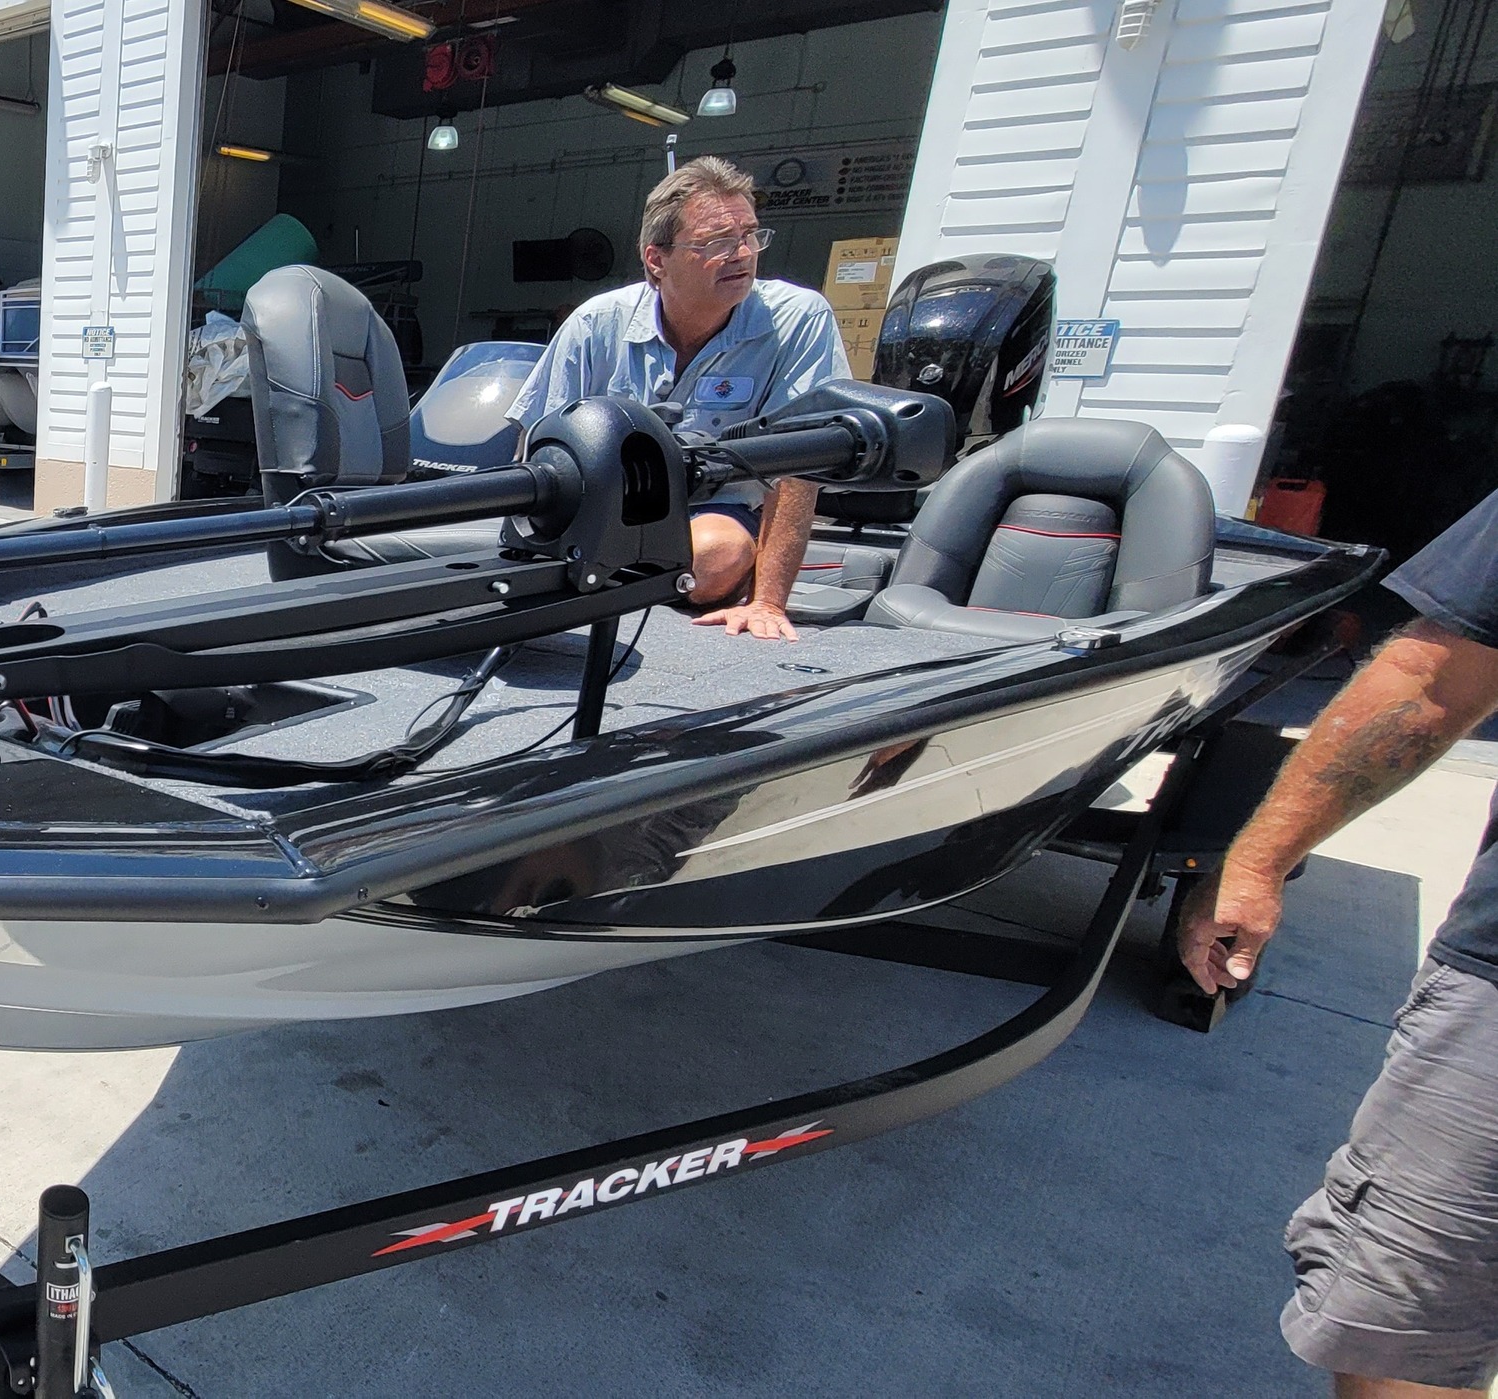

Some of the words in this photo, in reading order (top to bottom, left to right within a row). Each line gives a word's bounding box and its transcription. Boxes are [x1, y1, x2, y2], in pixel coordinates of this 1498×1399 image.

[770, 188, 812, 199] TRACKER
[767, 197, 791, 206] BOAT
[793, 195, 830, 205] CENTER
[86, 328, 110, 336] NOTICE
[1057, 323, 1107, 336] TICE
[1003, 329, 1048, 391] MERC
[1054, 358, 1083, 366] ONNEL
[412, 458, 478, 473] TRACKER
[487, 1137, 749, 1233] TRACKER
[50, 1286, 79, 1301] ITHA
